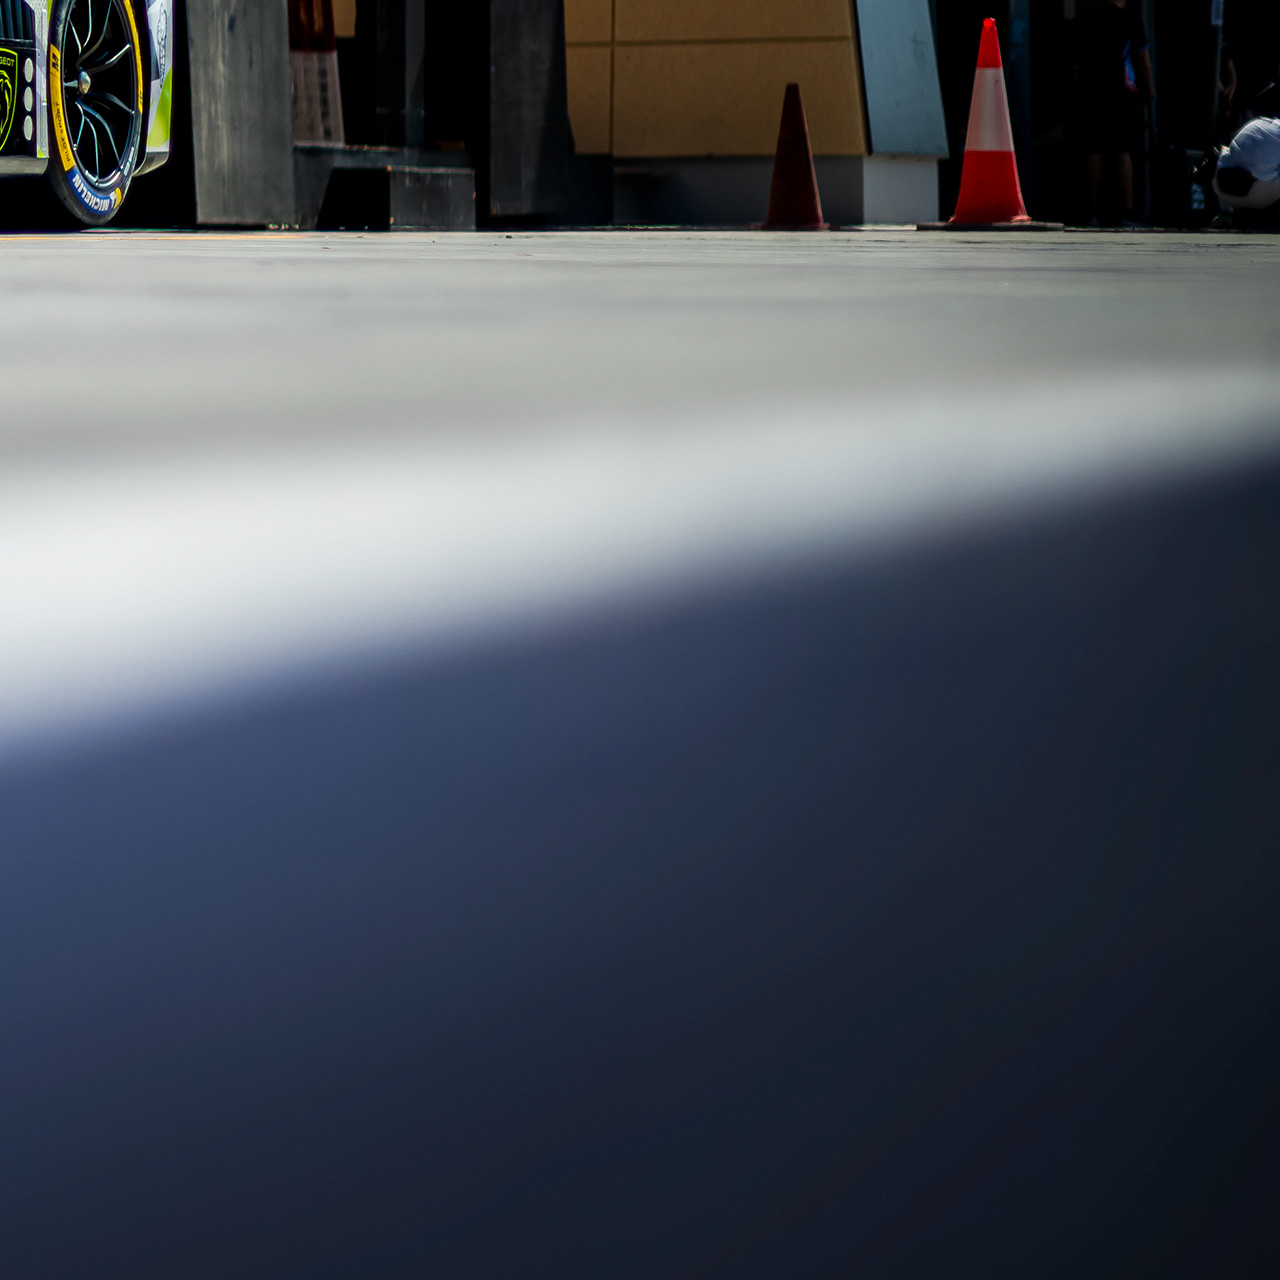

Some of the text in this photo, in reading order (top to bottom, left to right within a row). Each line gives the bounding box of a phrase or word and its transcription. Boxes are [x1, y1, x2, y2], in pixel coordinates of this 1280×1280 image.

[52, 52, 60, 71] M
[56, 101, 71, 162] PILOT SPORT
[72, 173, 110, 211] MICHELIN
